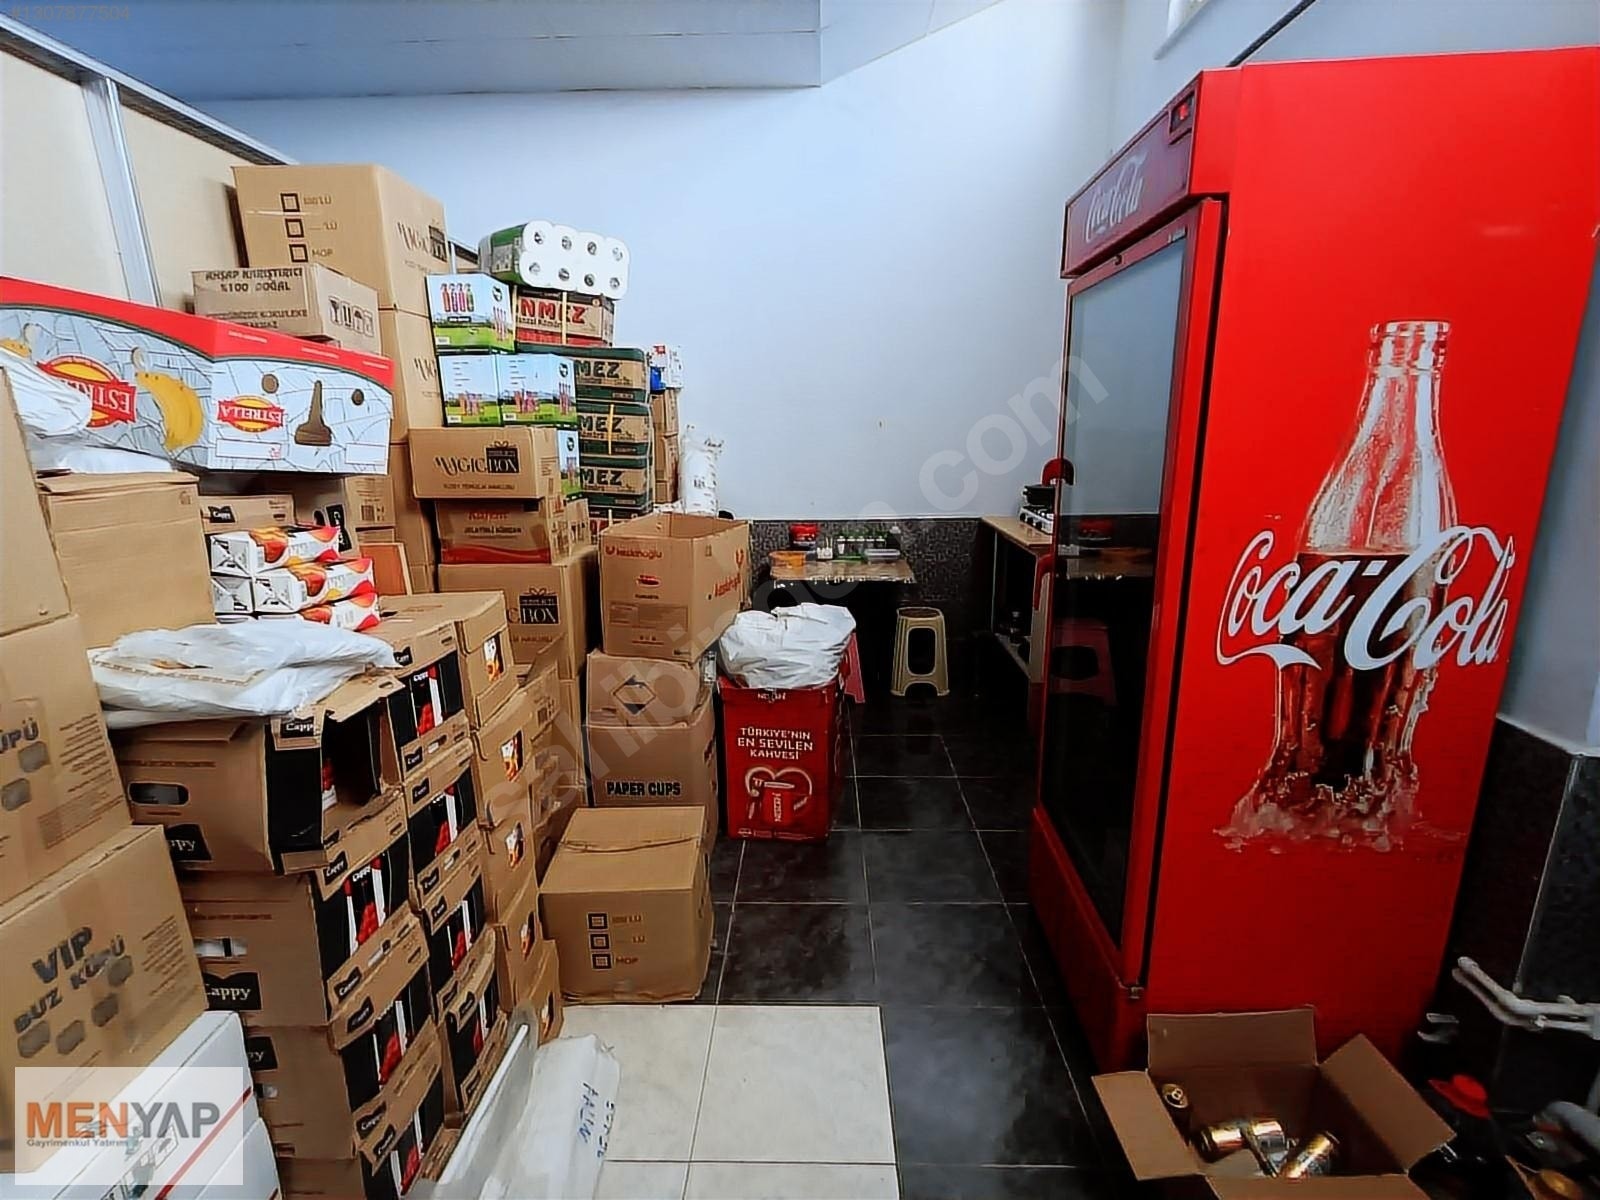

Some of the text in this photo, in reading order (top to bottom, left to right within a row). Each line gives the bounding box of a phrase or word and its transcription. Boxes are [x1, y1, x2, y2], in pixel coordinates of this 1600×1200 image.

[1085, 150, 1148, 243] Coca-Cola
[311, 249, 333, 258] MOP
[220, 282, 249, 292] %100
[218, 403, 283, 424] ESTRELLA
[1216, 525, 1516, 672] Coca-Cola
[737, 737, 755, 747] EN
[606, 781, 681, 796] PAPER CUPS
[32, 926, 92, 984] VIP
[14, 987, 62, 1034] BUZ
